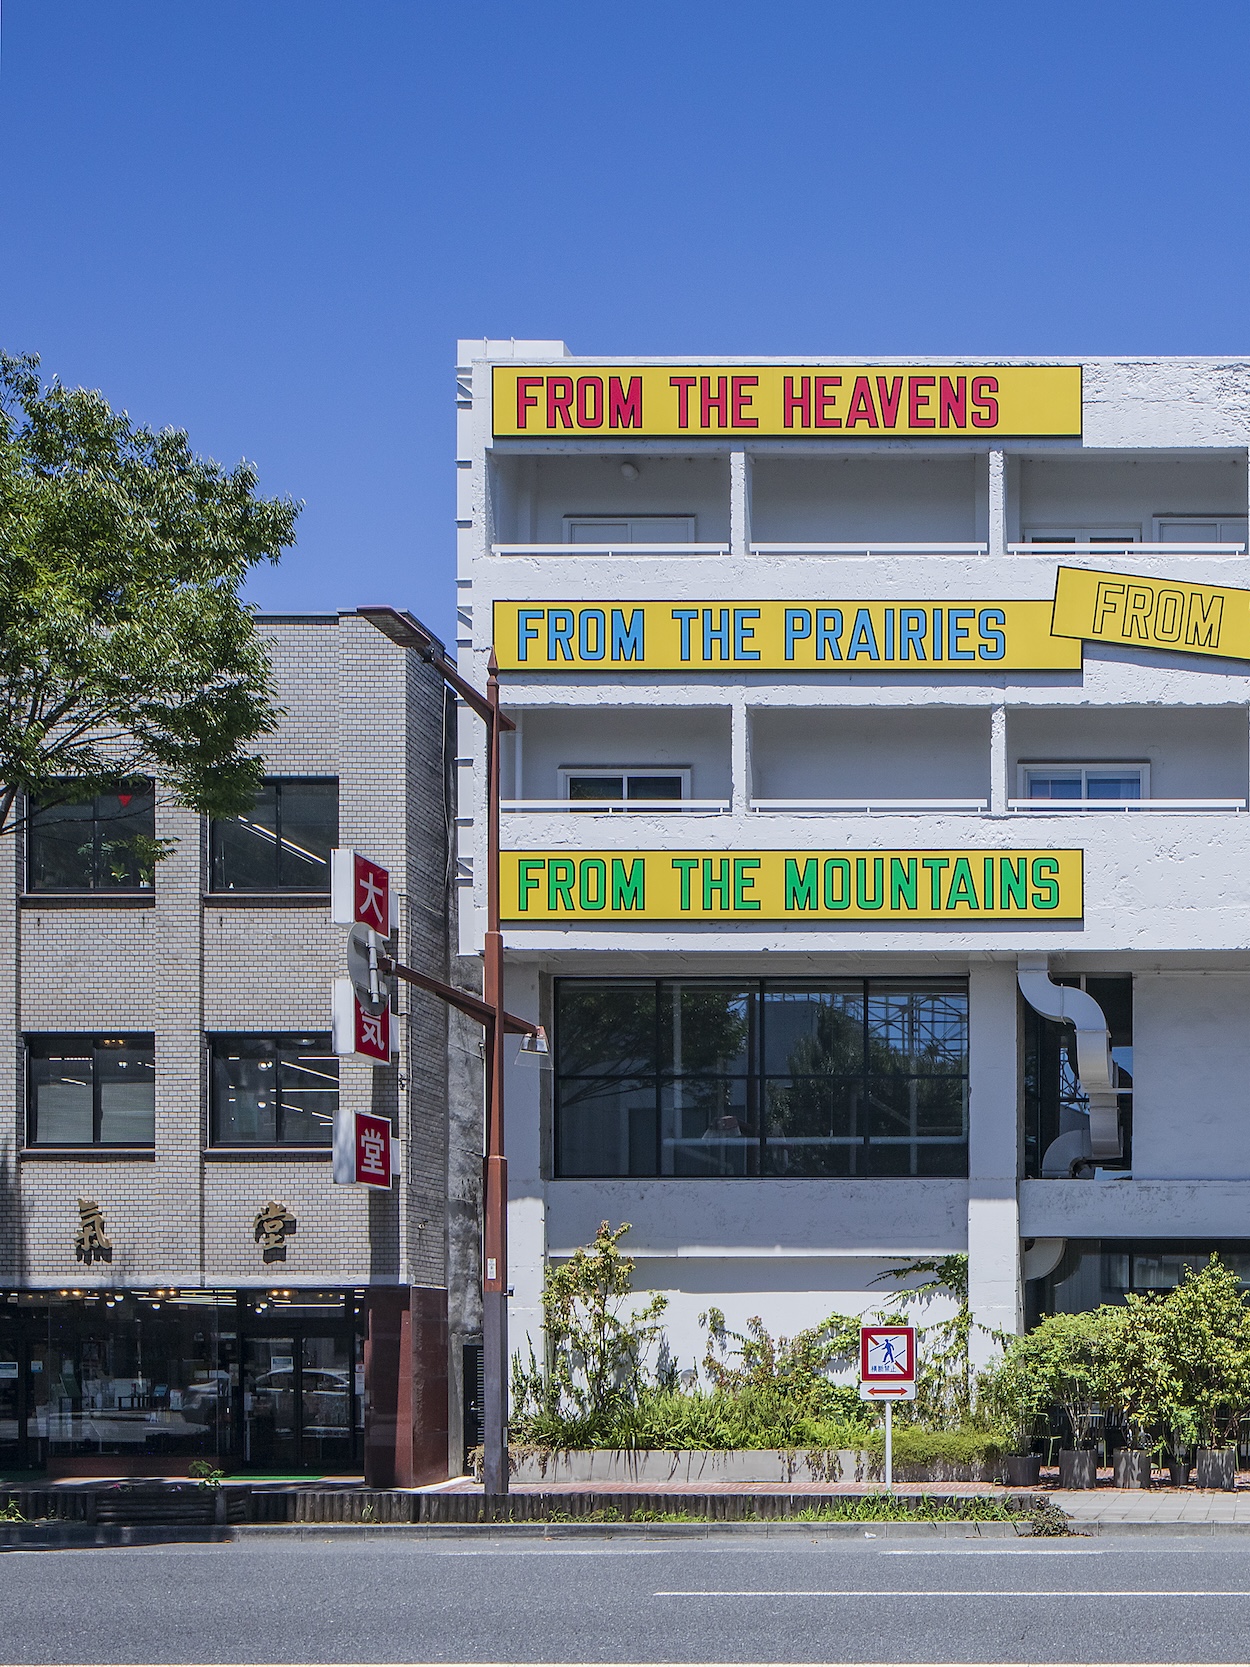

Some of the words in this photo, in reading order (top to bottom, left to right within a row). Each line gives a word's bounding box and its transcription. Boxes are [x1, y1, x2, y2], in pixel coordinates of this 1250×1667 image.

[515, 376, 643, 429] FROM
[669, 376, 760, 429] THE
[783, 376, 1000, 429] HEAVENS
[517, 608, 646, 662] FROM
[671, 608, 762, 662] THE
[784, 608, 1007, 662] PRAIRIES
[1092, 581, 1225, 649] FROM
[517, 857, 646, 911] FROM
[671, 857, 762, 911] THE
[784, 857, 1060, 911] MOUNTAINS
